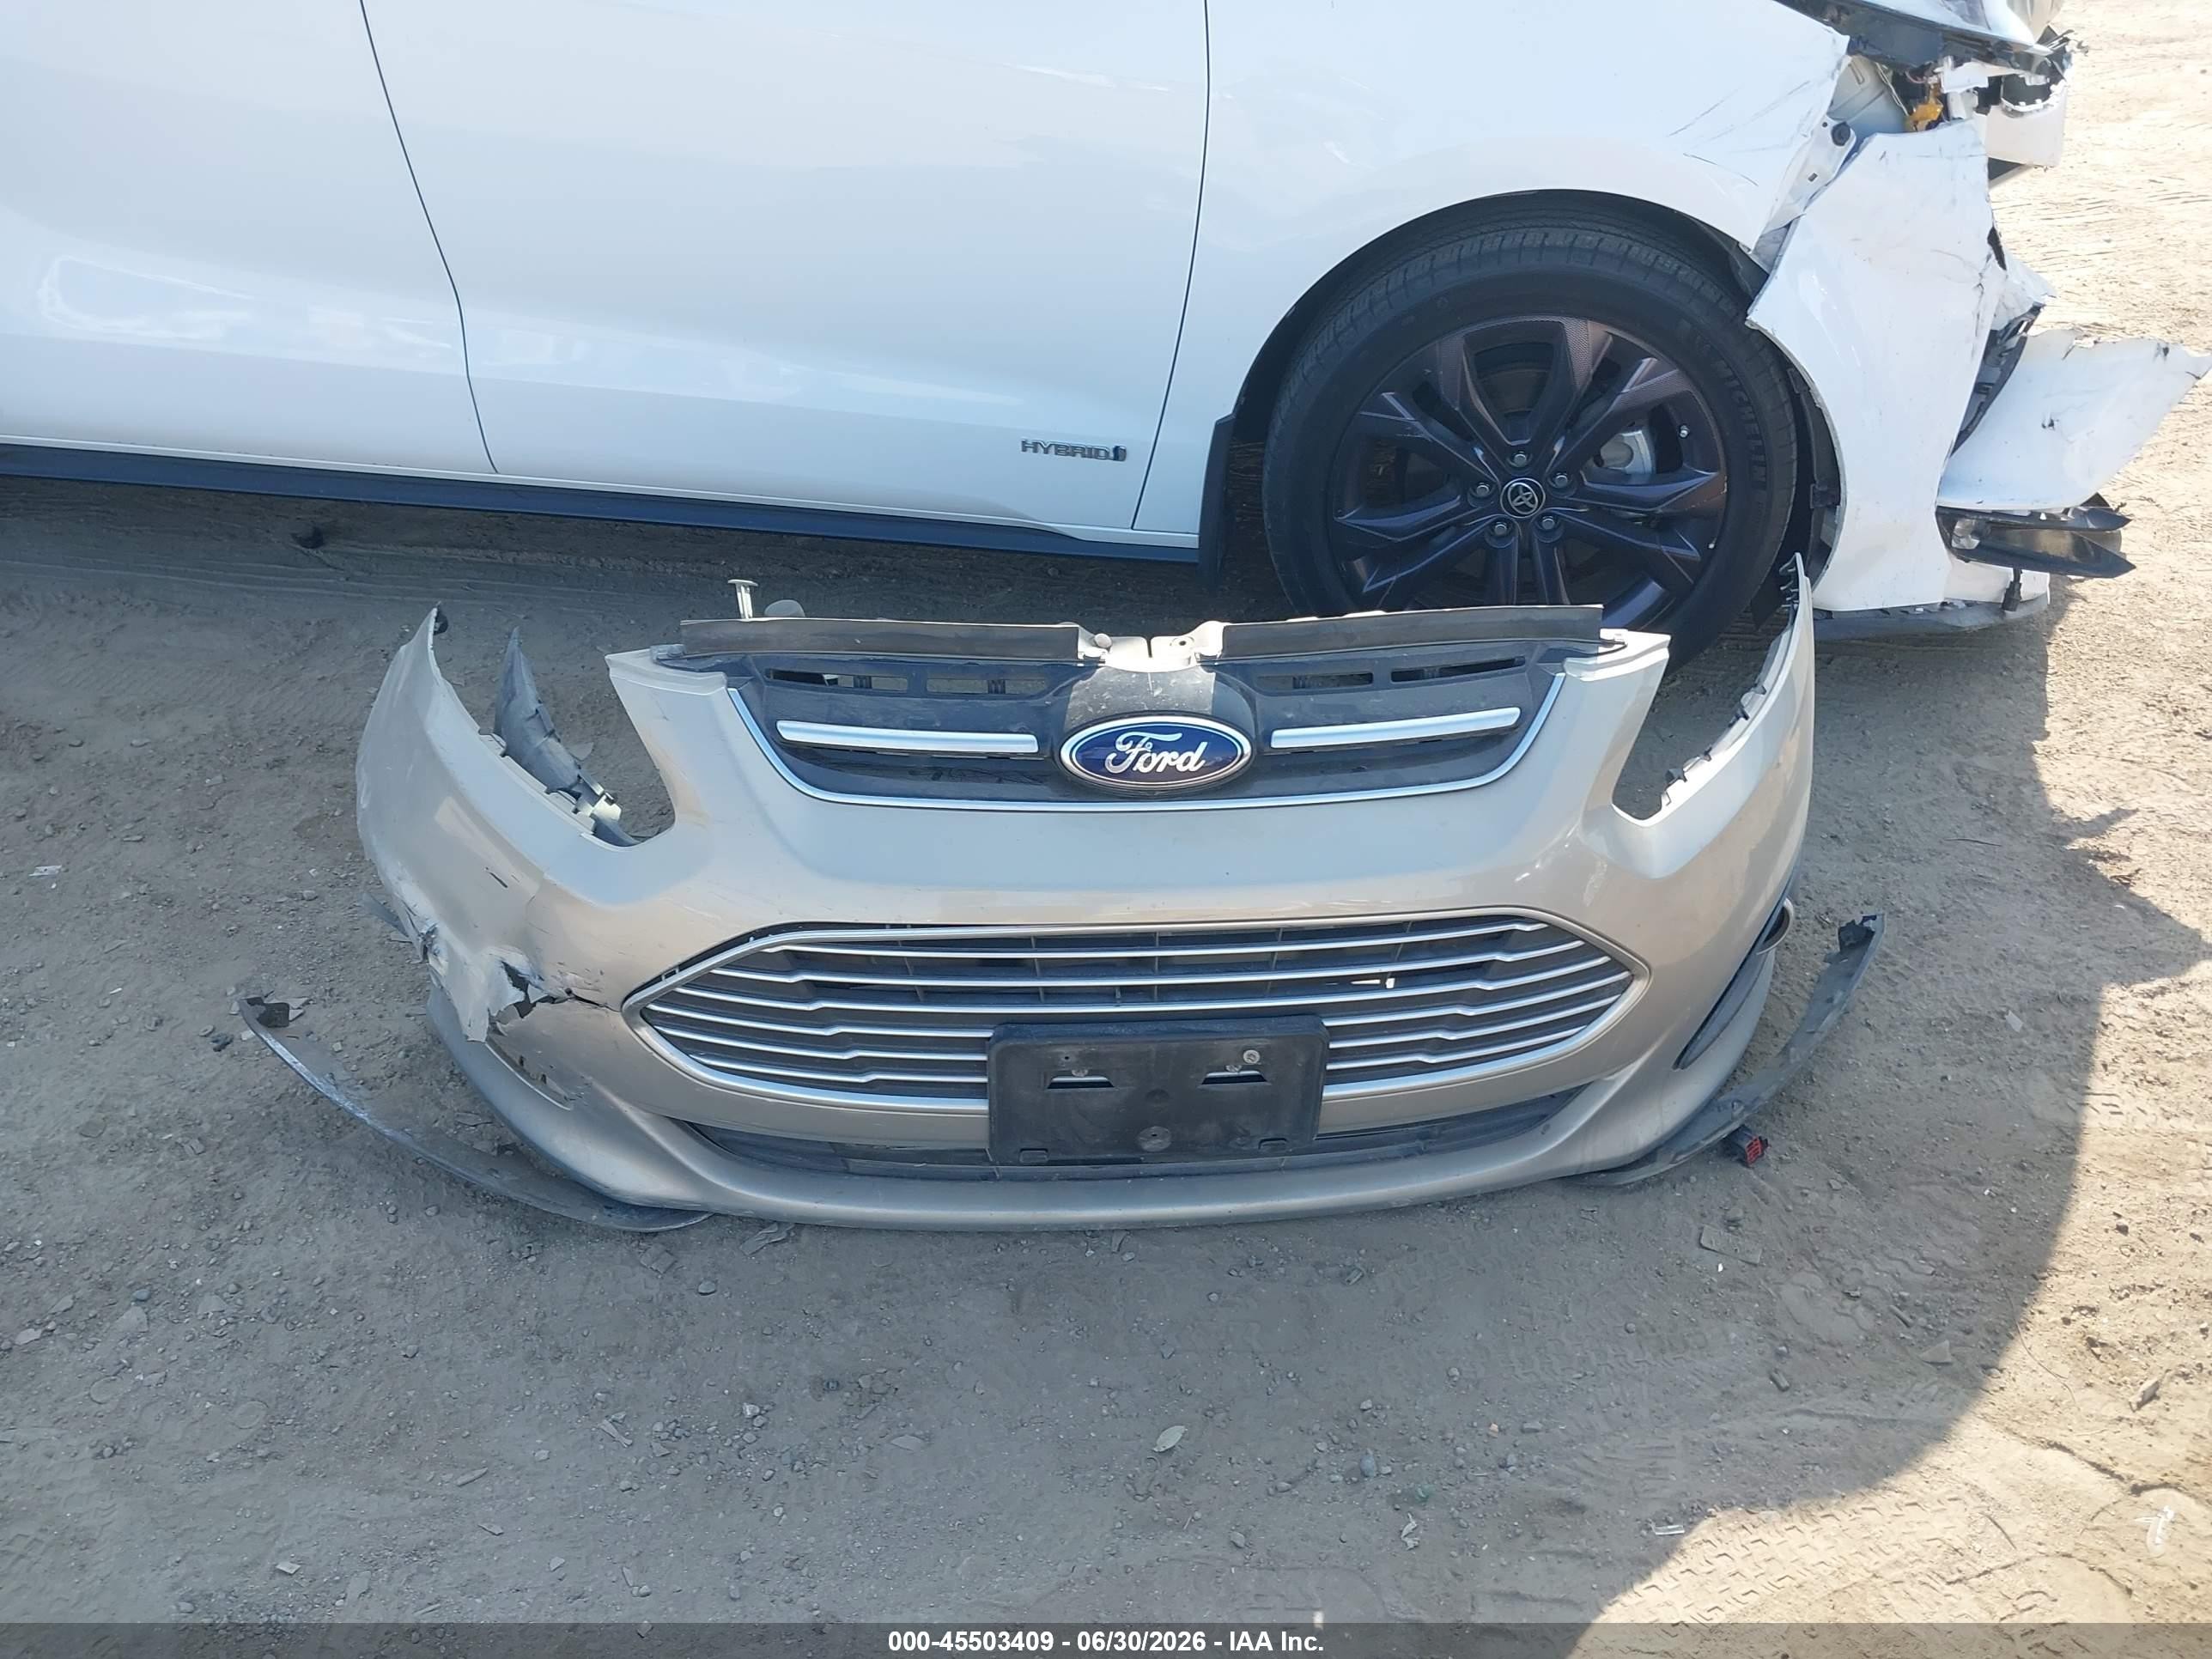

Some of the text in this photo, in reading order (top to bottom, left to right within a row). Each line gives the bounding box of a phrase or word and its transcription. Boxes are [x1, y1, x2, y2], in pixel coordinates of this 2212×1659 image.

[1711, 359, 1768, 490] MICHELIN
[1021, 439, 1110, 460] HYBRID
[1104, 731, 1209, 775] Ford
